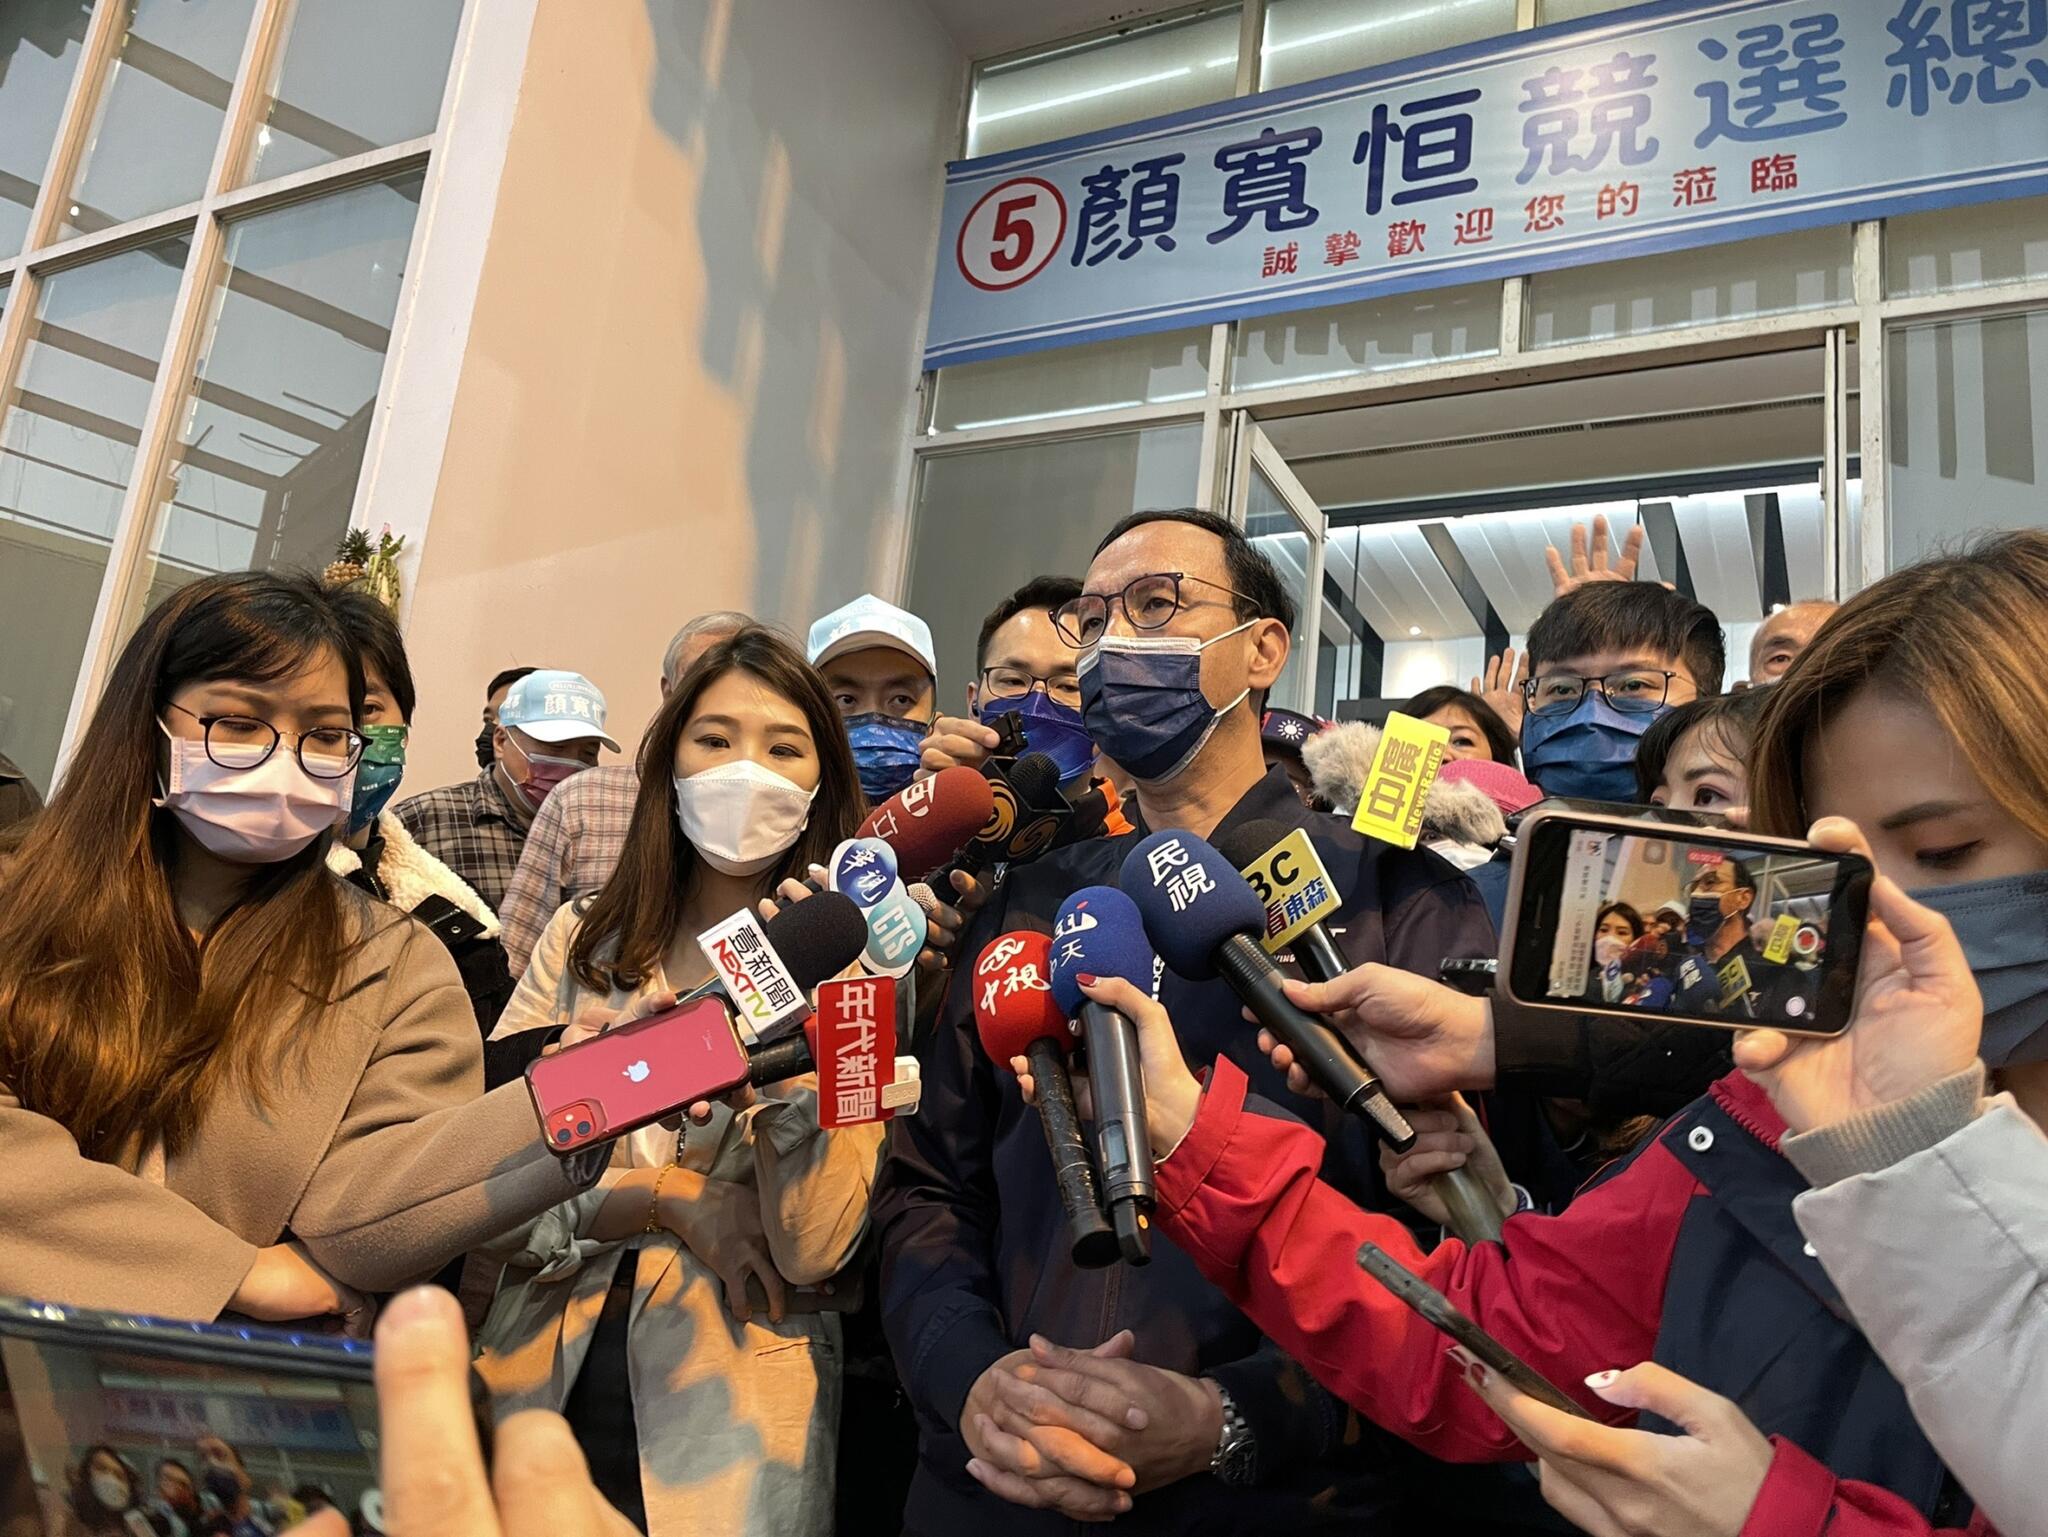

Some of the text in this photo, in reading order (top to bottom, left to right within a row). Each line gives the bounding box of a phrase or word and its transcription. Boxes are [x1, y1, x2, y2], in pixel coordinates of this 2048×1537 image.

[989, 194, 1038, 272] 5
[1367, 736, 1423, 822] 中廣
[1406, 747, 1443, 829] NewsRadio
[1147, 838, 1216, 912] 民視
[728, 924, 797, 1012] 壹新聞
[872, 904, 917, 960] CTS
[835, 981, 878, 1124] 年代新聞
